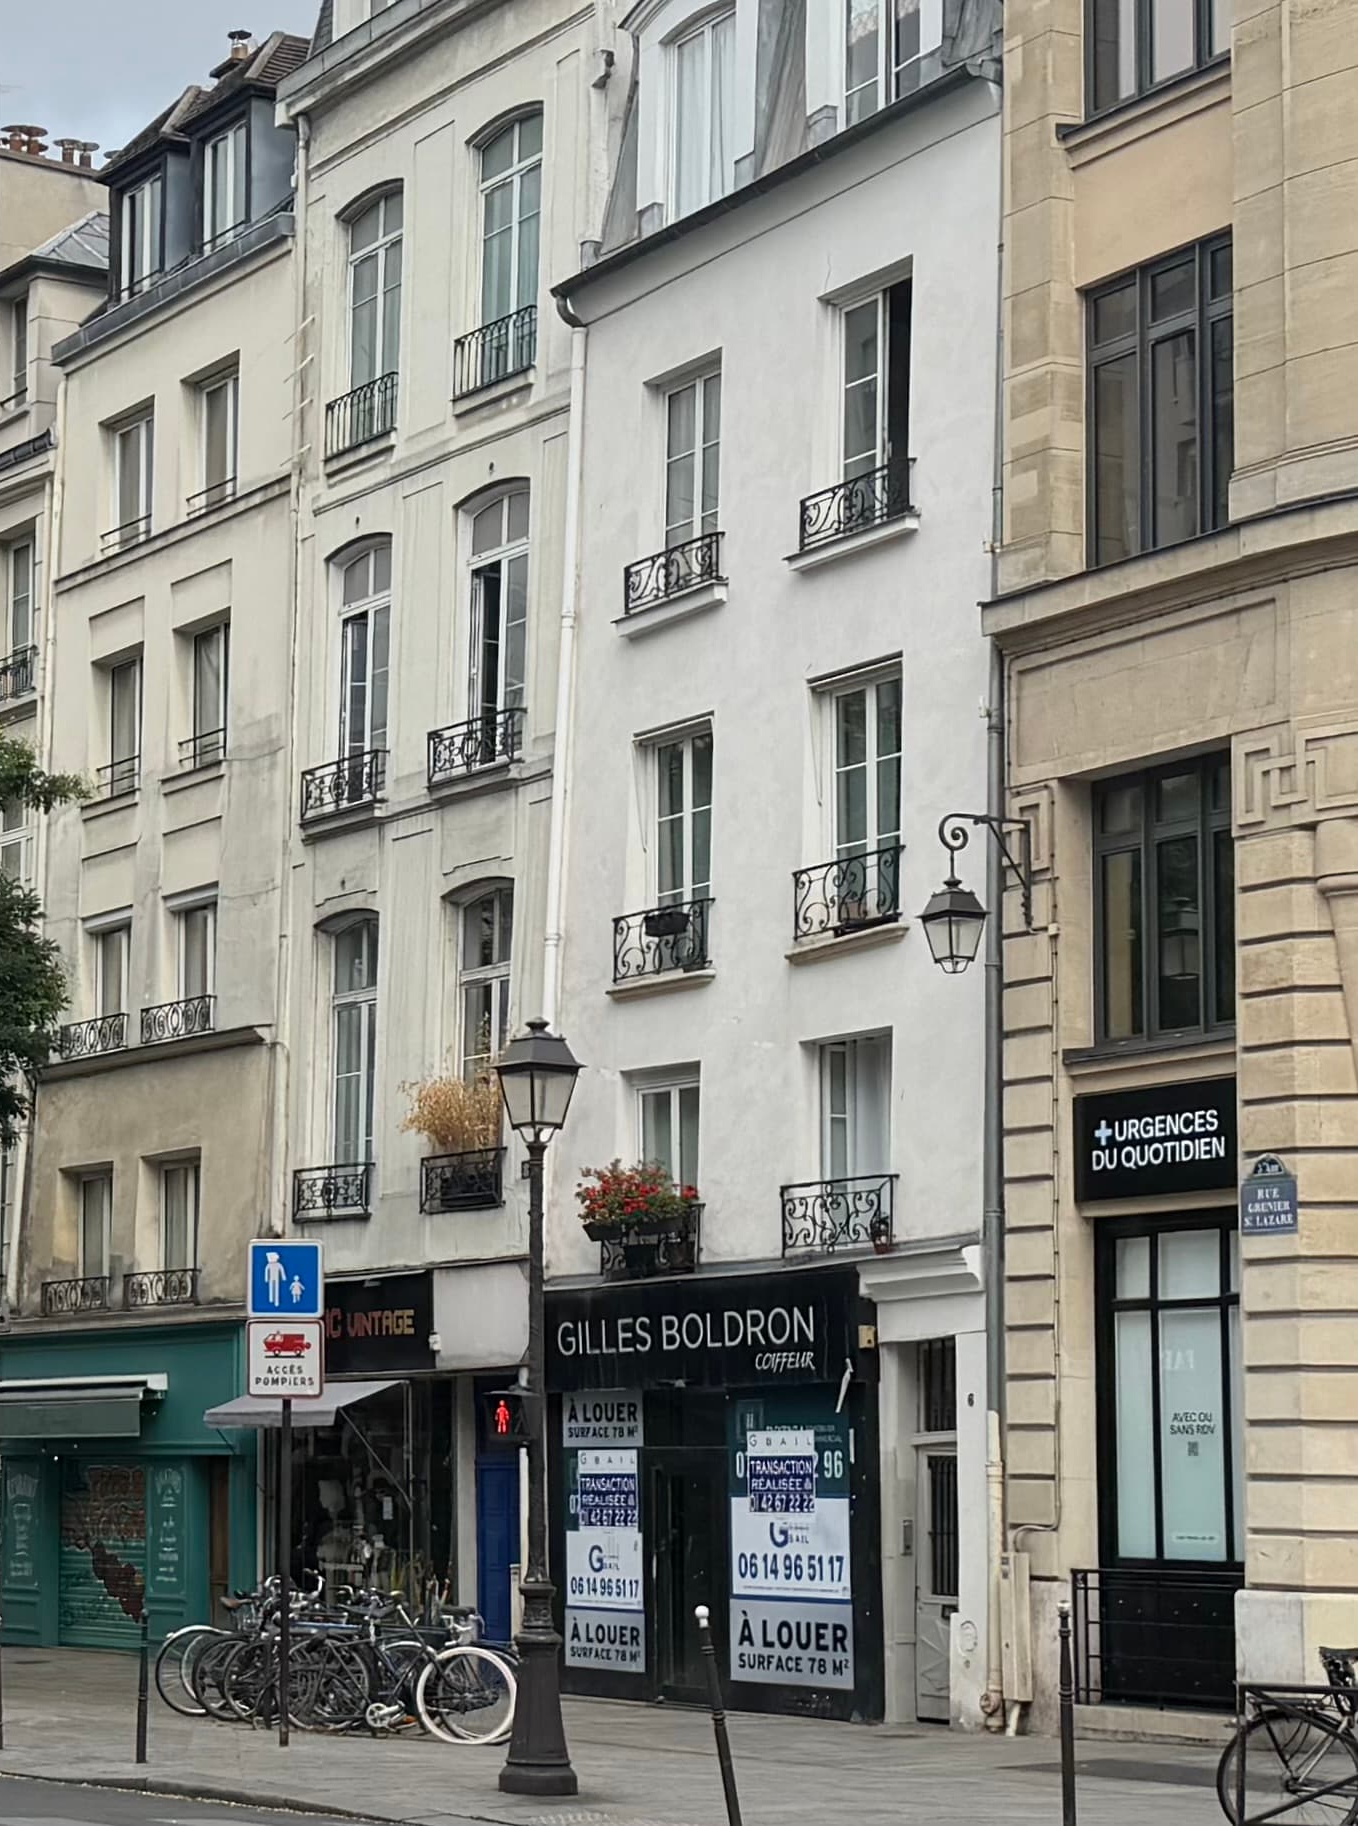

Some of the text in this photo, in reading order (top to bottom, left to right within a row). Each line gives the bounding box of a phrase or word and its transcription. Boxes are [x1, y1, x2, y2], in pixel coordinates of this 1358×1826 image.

[1114, 1109, 1219, 1142] URGENCES
[1092, 1136, 1226, 1171] DU QUOTIDIEN
[1257, 1187, 1280, 1199] RUE
[1256, 1213, 1293, 1226] LAZARE
[347, 1309, 415, 1337] VINTAGE
[557, 1305, 814, 1355] GILLES BOLDRON
[754, 1351, 816, 1374] COIFFEUR
[255, 1377, 314, 1386] POMPIERS
[967, 1393, 974, 1407] 6
[568, 1398, 638, 1423] À LOUER
[1172, 1412, 1212, 1422] AVEC OU
[568, 1427, 610, 1438] SURFACE
[613, 1426, 624, 1438] 78
[1170, 1424, 1216, 1435] SANS RDV
[750, 1460, 812, 1475] TRANSACTION
[824, 1450, 843, 1478] 96
[580, 1478, 635, 1491] TRANSACTION
[761, 1494, 773, 1512] 42
[775, 1495, 786, 1512] 67
[789, 1495, 800, 1512] 22
[615, 1509, 625, 1526] 22
[739, 1553, 844, 1582] 06 14 96 51 17
[570, 1576, 639, 1598] 06 14 96 51 17
[570, 1616, 640, 1647] À LOUER
[739, 1610, 848, 1653] À LOUER
[570, 1646, 612, 1660] SURFACE
[615, 1650, 627, 1662] 78
[738, 1652, 803, 1672] SURFACE
[808, 1657, 827, 1675] 78
